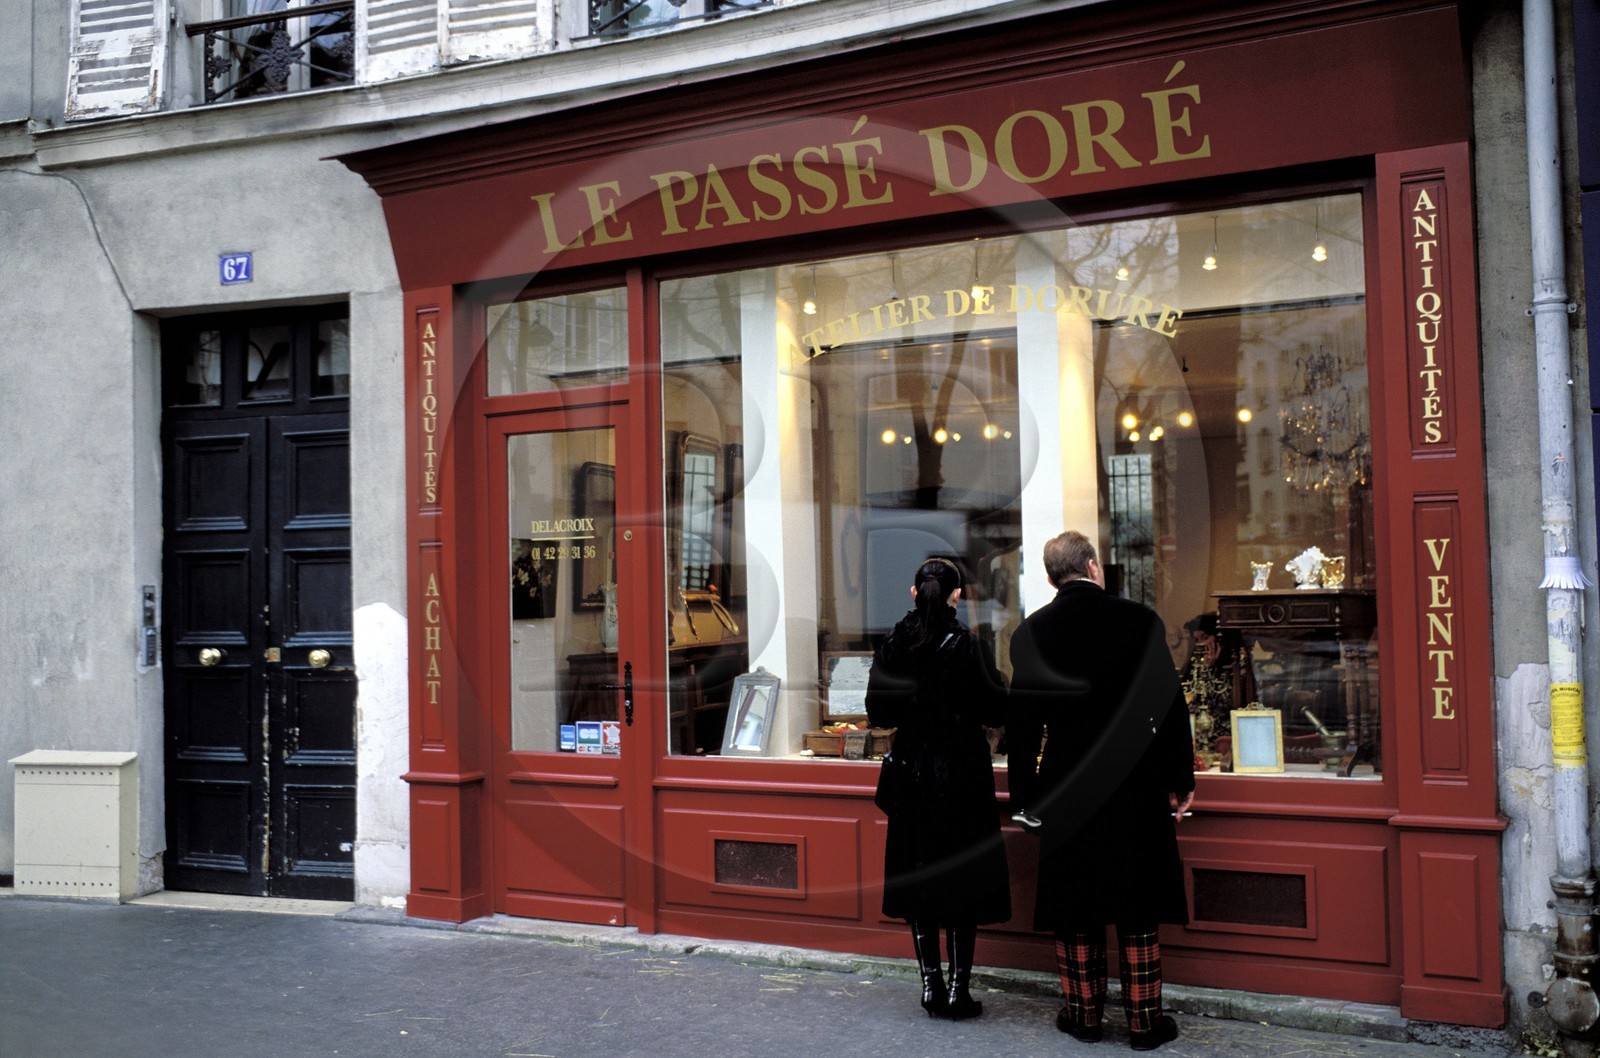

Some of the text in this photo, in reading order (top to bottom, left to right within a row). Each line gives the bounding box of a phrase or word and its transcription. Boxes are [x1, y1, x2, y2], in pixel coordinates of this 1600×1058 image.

[531, 60, 1211, 254] LE PASSÉ DORÉ
[224, 256, 248, 280] 67
[789, 284, 1184, 370] ATELIER DE DORURE
[1413, 189, 1442, 444] ANTIQUITÉS
[422, 322, 437, 503] ANTIQUITÉS
[531, 547, 541, 560] 01
[543, 546, 556, 560] 42
[571, 545, 581, 559] 31
[583, 545, 596, 559] 36
[532, 518, 594, 533] DELACROIX
[424, 573, 441, 704] ACHAT
[1423, 538, 1455, 720] VENTE
